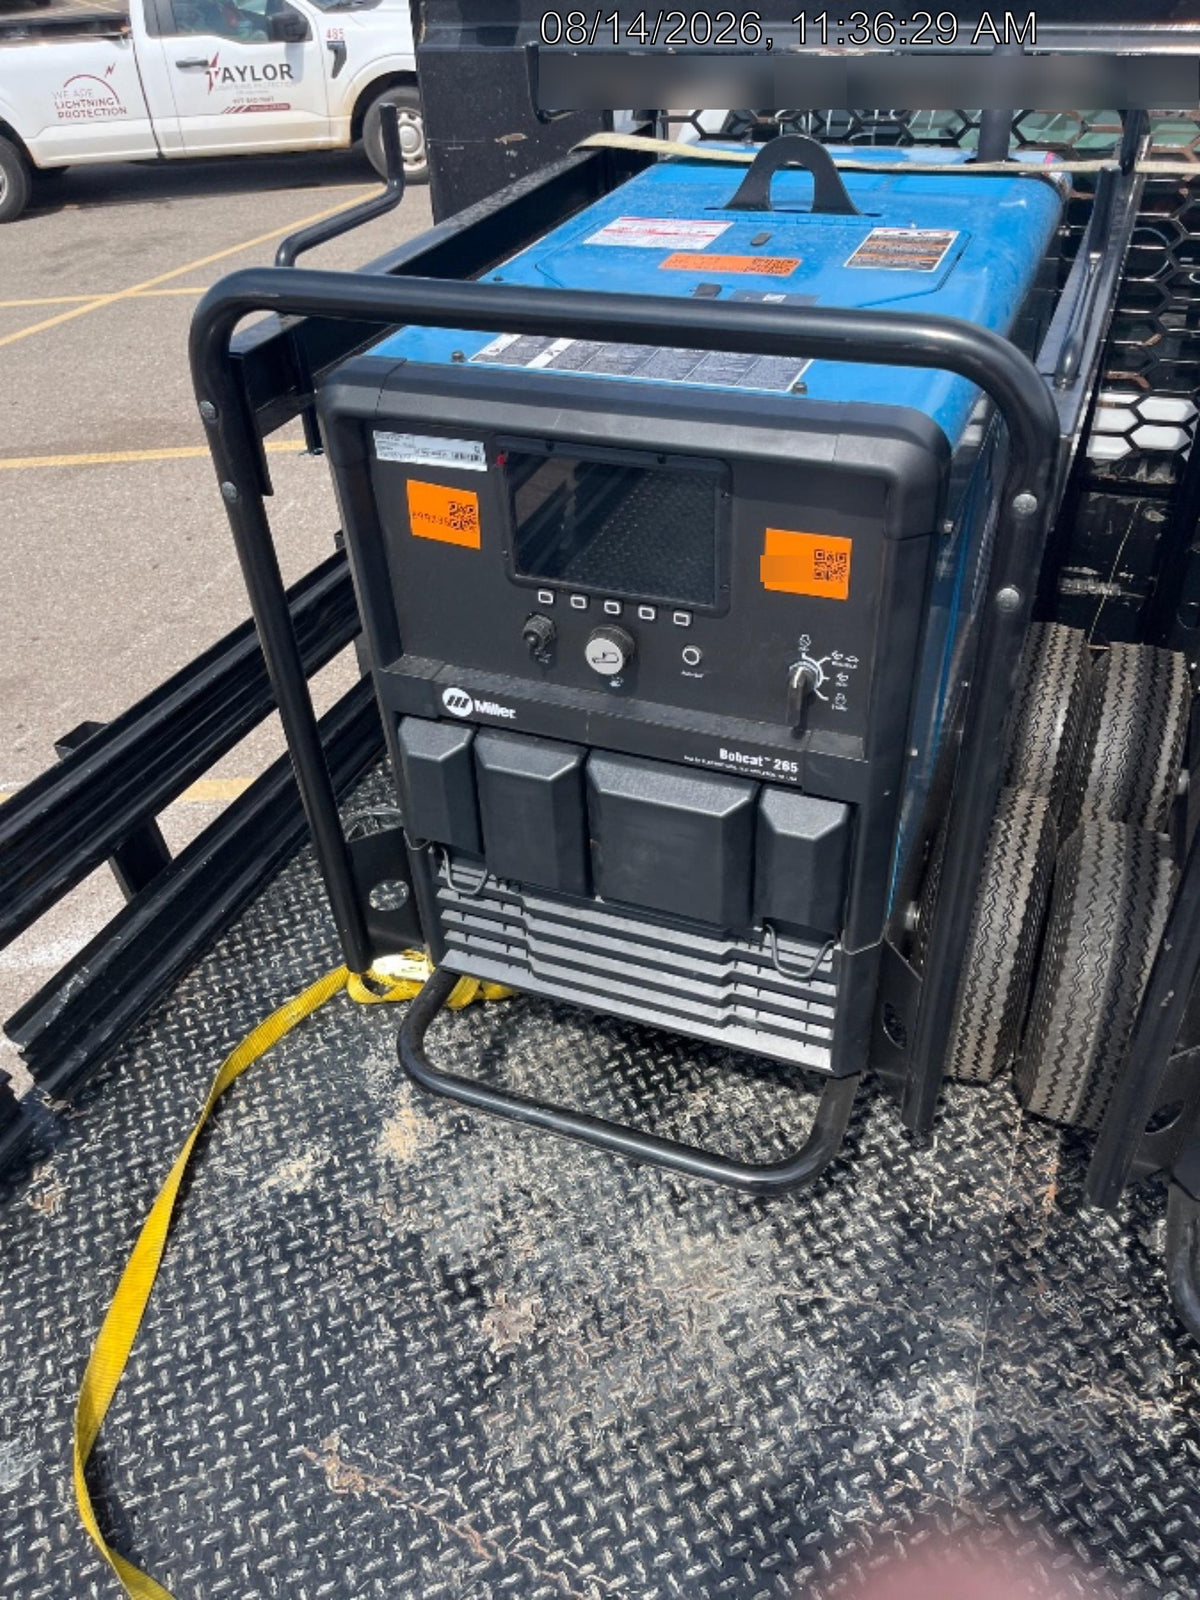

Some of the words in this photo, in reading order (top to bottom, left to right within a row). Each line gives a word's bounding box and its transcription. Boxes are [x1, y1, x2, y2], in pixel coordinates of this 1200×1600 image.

[57, 106, 127, 119] PROTECTION
[474, 698, 517, 719] Miller
[772, 758, 800, 774] 265
